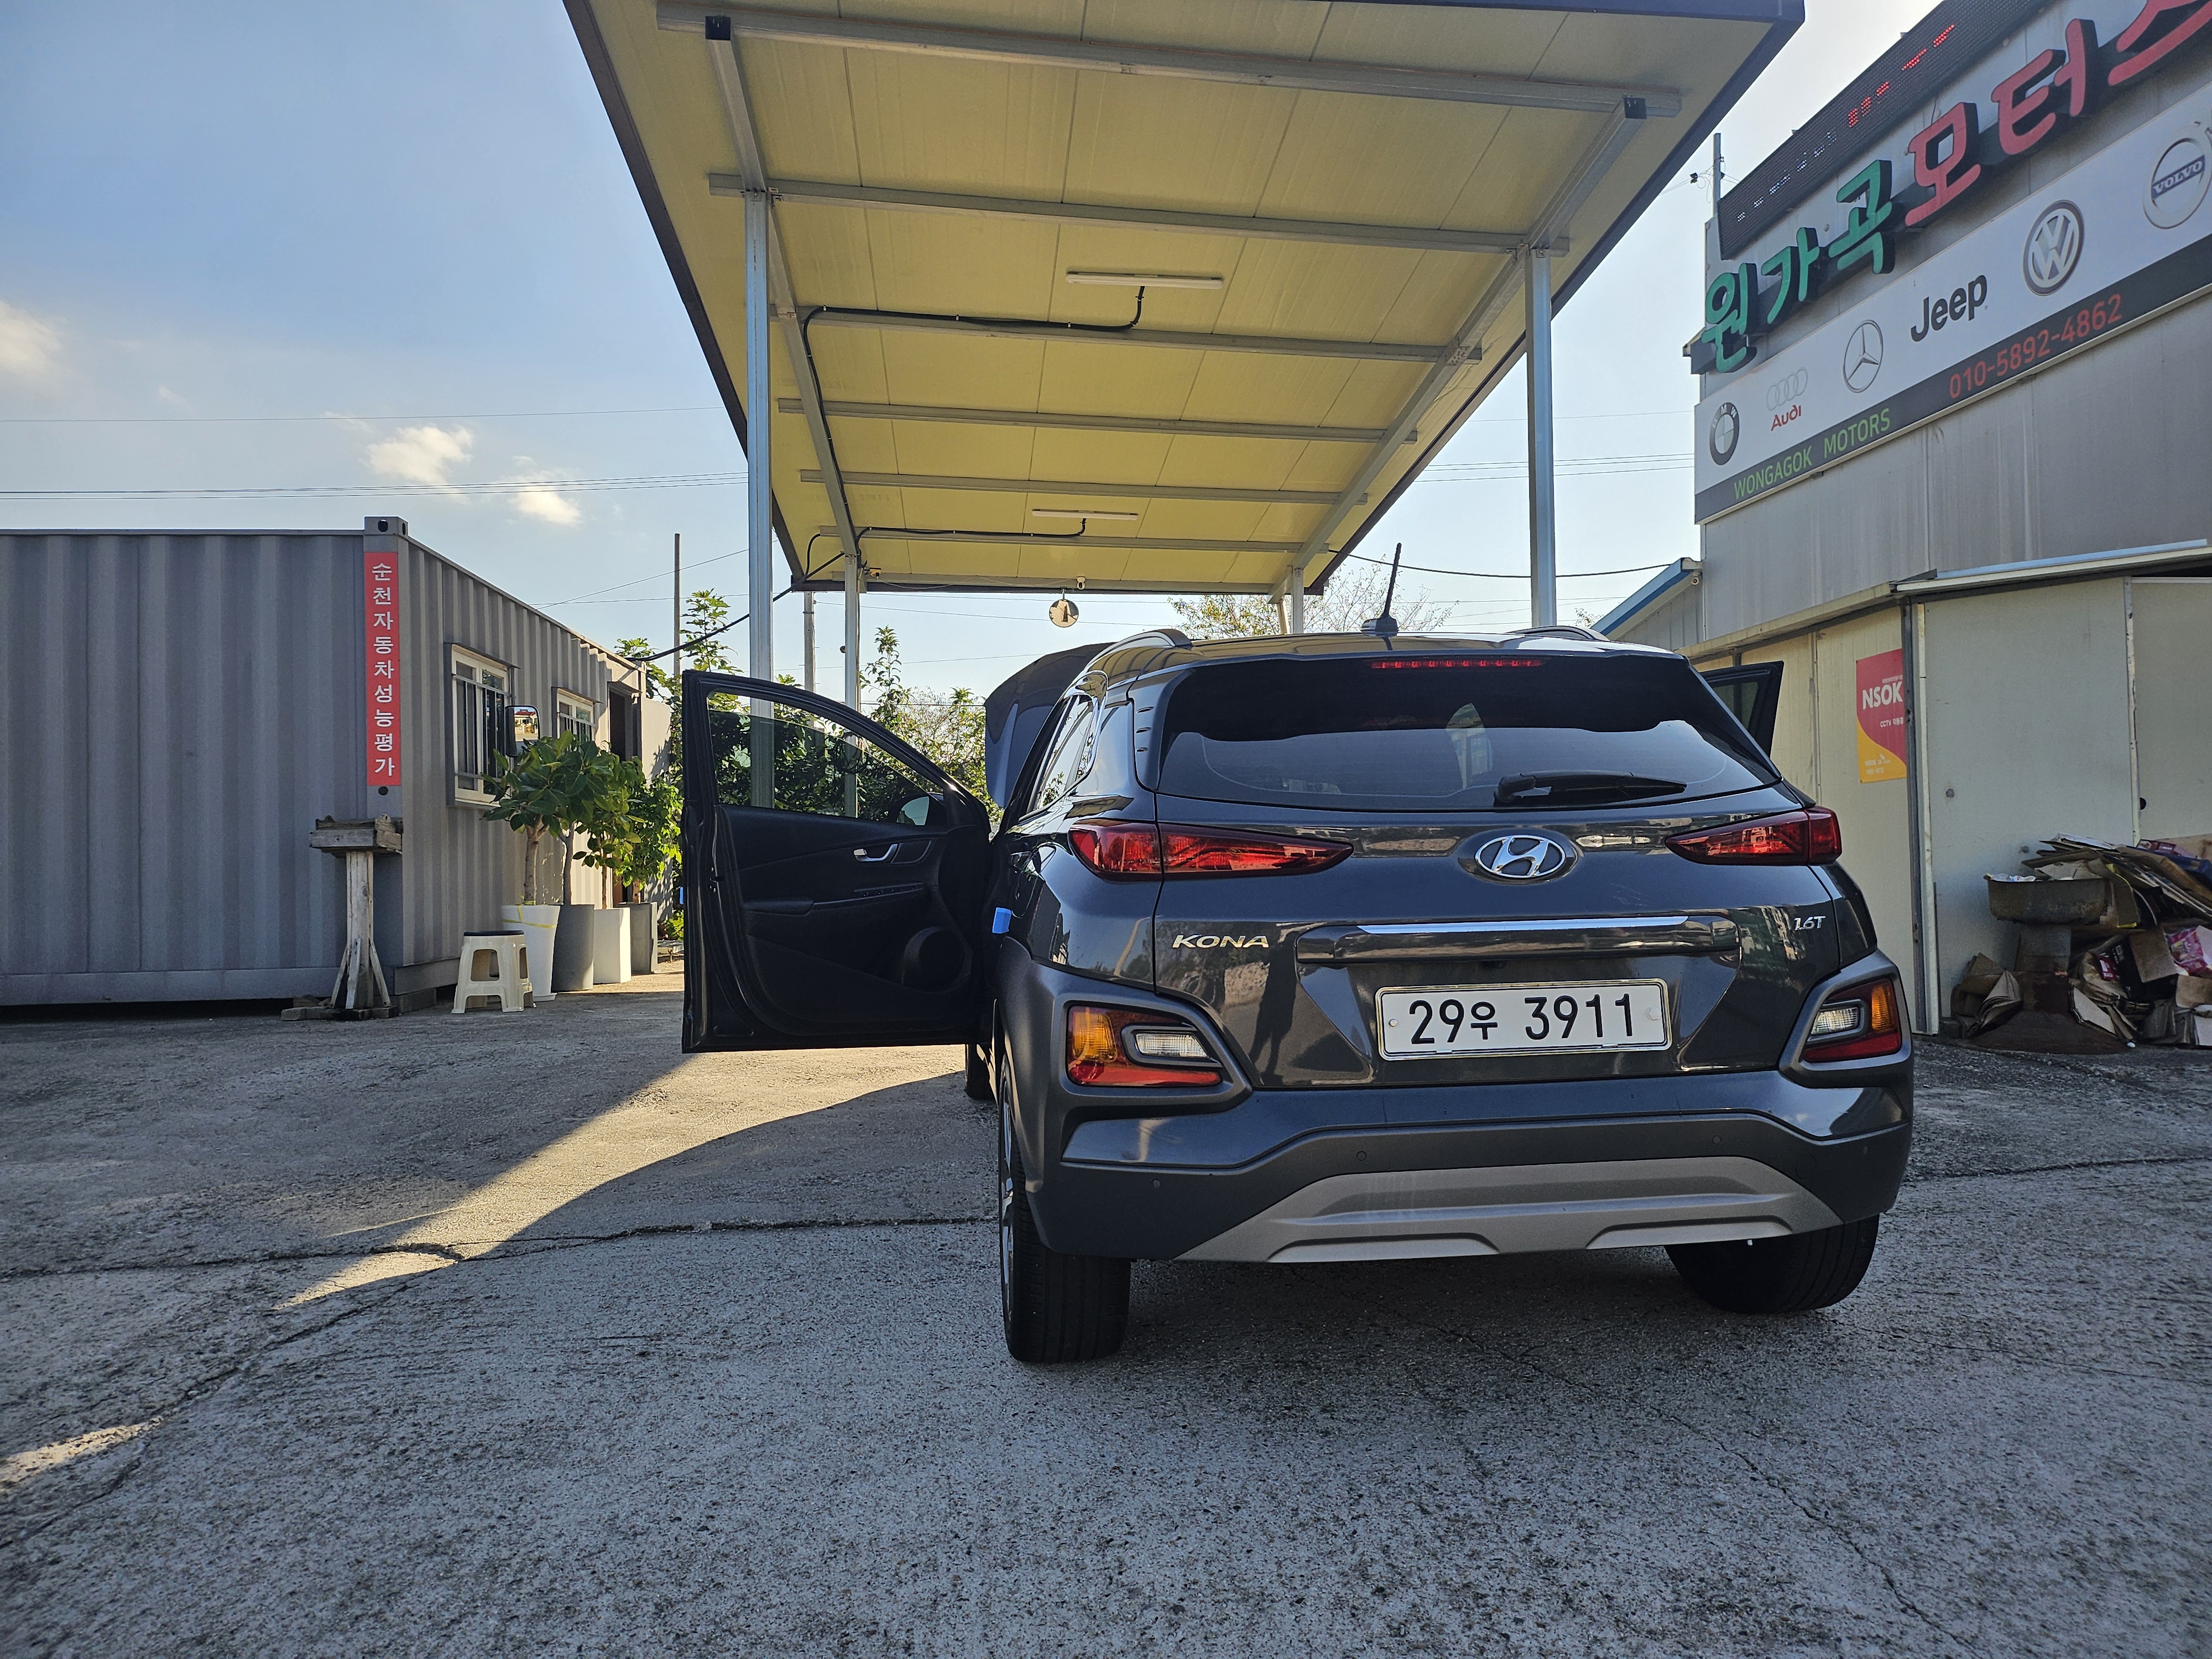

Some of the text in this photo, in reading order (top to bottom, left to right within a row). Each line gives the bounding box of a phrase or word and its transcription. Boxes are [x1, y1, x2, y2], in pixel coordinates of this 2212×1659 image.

[2152, 160, 2203, 194] VOLVO
[1701, 159, 1892, 373] 원가곡
[1911, 275, 1987, 342] Jeep
[1949, 294, 2122, 399] 010-5892-4862
[1771, 404, 1802, 431] Audi
[1734, 408, 1891, 500] WONGAGOK MOTORS
[372, 562, 395, 777] 순천자동차성능평가
[1862, 681, 1903, 710] NSOK
[1880, 719, 1891, 728] CCTV
[1172, 934, 1270, 948] KONA
[1793, 915, 1826, 931] 1.6T
[1408, 993, 1633, 1045] 29우 3911
